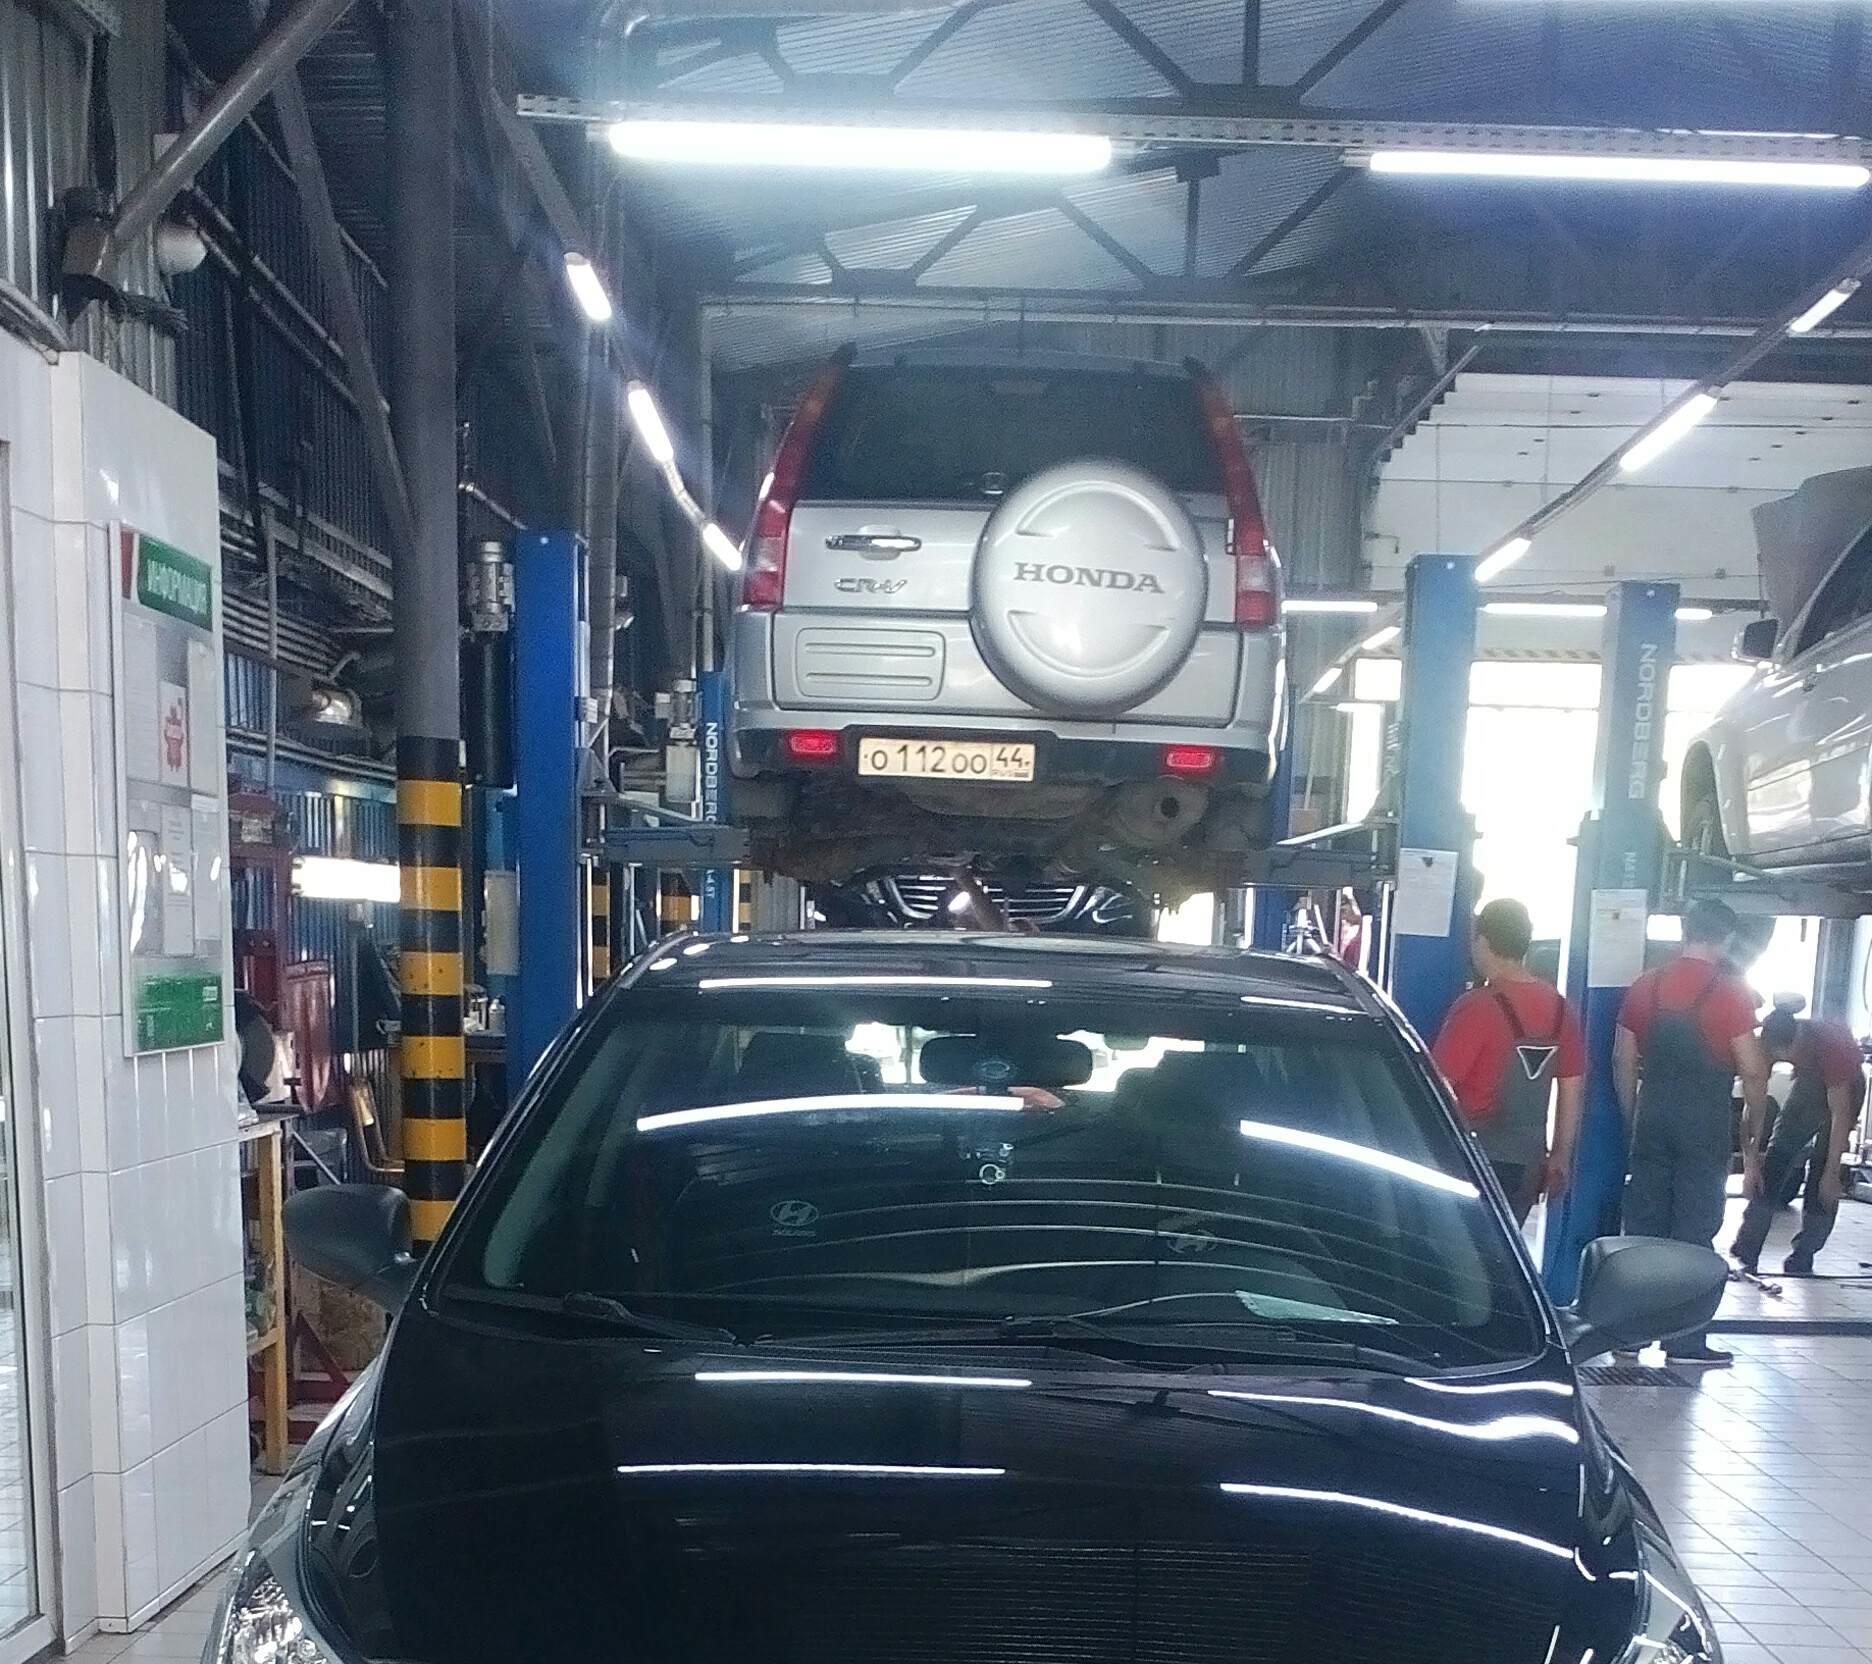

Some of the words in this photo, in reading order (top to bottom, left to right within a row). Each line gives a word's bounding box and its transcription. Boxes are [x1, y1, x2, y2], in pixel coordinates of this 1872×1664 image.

[1012, 561, 1166, 594] HONDA
[1628, 642, 1658, 800] NORDBERG
[996, 746, 1023, 768] 44
